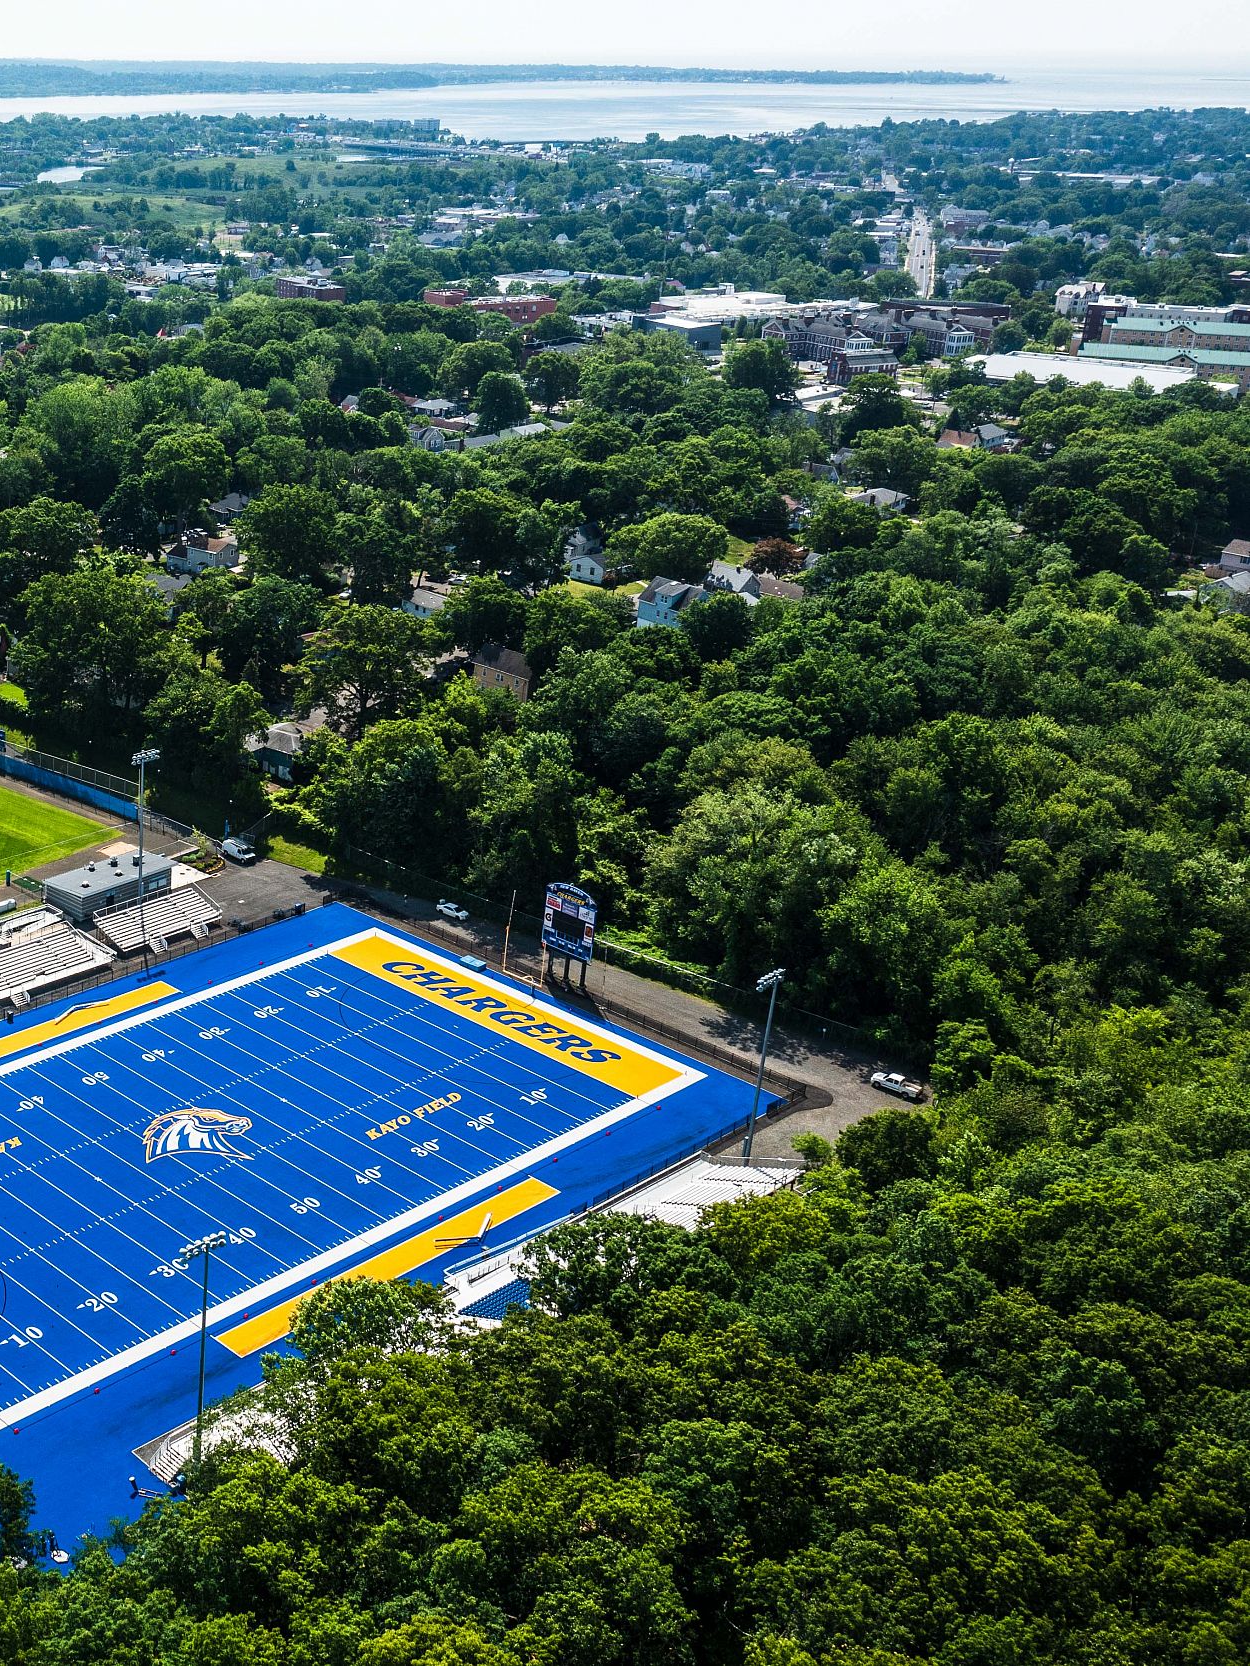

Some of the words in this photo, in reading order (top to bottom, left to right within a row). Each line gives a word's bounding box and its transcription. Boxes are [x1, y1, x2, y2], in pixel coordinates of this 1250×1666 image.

[557, 892, 586, 905] CHARGERS
[545, 912, 552, 922] G
[305, 985, 331, 998] 10
[253, 1005, 279, 1019] 20
[382, 960, 623, 1065] CHARGERS
[198, 1026, 226, 1040] 30
[141, 1049, 167, 1062] 40
[82, 1071, 110, 1086] 50
[19, 1095, 44, 1110] 40
[519, 1089, 549, 1106] 10
[365, 1115, 411, 1141] KAYO
[413, 1092, 462, 1119] FIELD
[466, 1115, 495, 1132] 20
[410, 1141, 439, 1157] 30
[355, 1168, 382, 1186] 40
[289, 1197, 321, 1215] 50
[228, 1227, 256, 1245] 40
[84, 1291, 119, 1313] 20
[7, 1326, 43, 1348] 10
